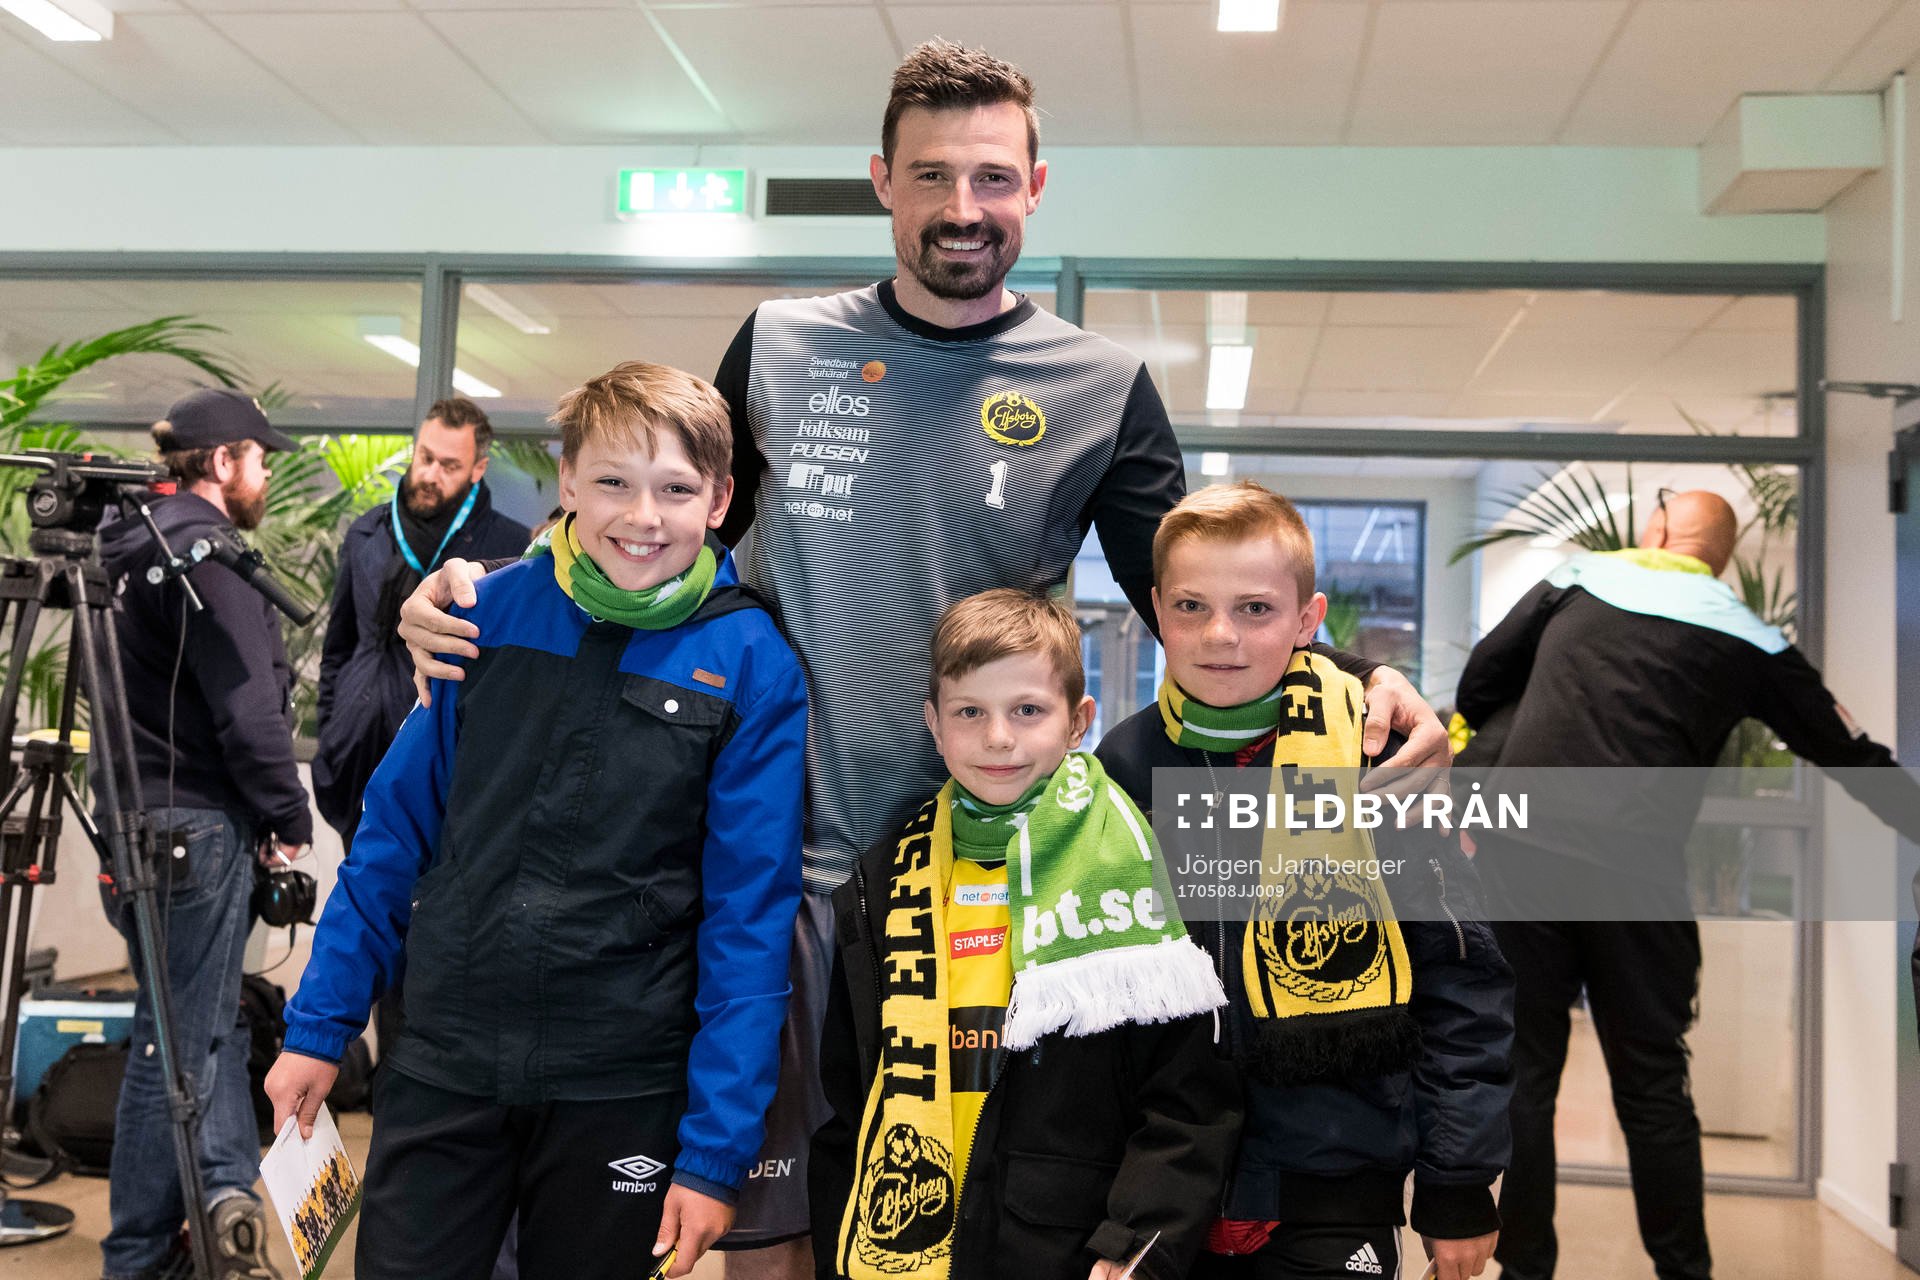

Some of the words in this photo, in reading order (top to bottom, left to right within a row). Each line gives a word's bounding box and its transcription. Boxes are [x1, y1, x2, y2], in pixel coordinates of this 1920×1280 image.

[808, 368, 848, 379] Sjuhärad
[811, 357, 858, 369] Swedbank
[808, 386, 870, 416] ellos
[990, 405, 1037, 431] Elfsborg
[796, 420, 869, 442] Folksam
[789, 443, 869, 463] PULSEN
[985, 460, 1007, 509] 1
[1023, 887, 1168, 955] bt.se
[954, 933, 1005, 951] STAPLES
[949, 1023, 1006, 1050] ban
[883, 1026, 937, 1102] IF
[612, 1180, 657, 1193] umbro
[1345, 1260, 1383, 1274] adidas
